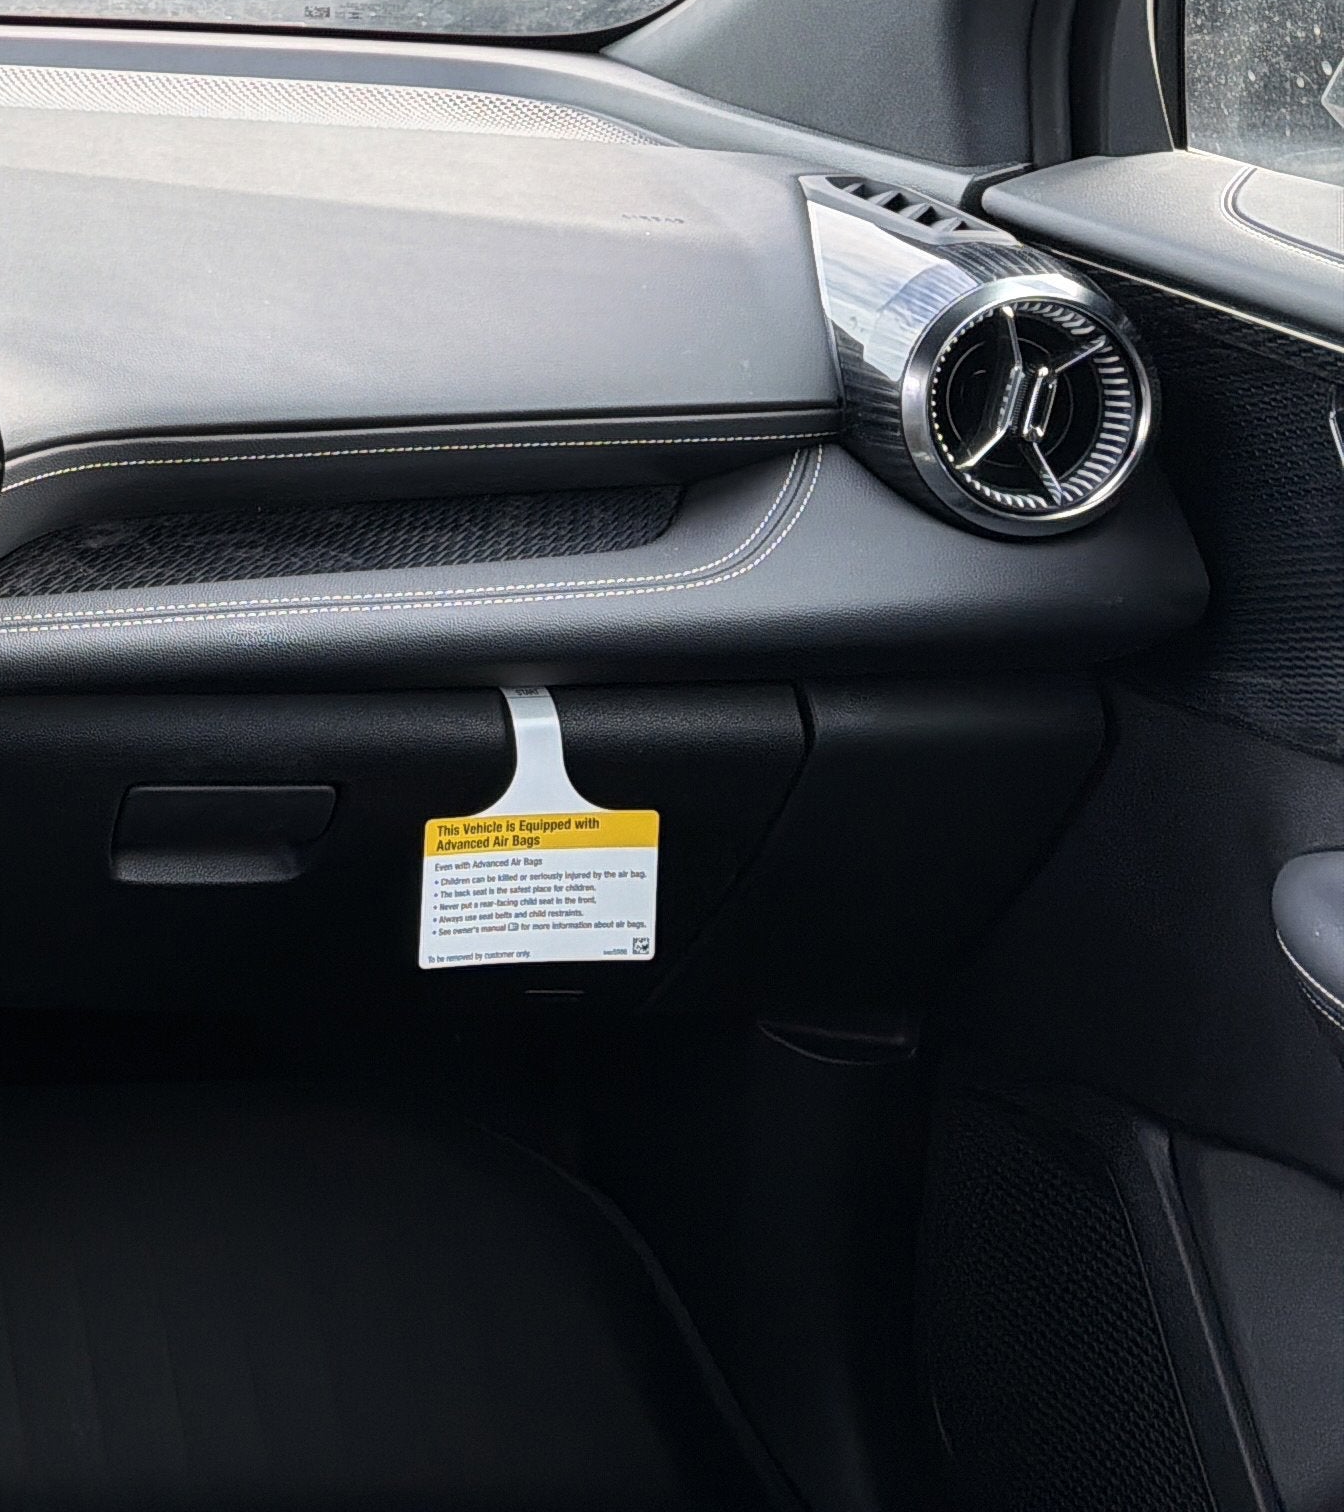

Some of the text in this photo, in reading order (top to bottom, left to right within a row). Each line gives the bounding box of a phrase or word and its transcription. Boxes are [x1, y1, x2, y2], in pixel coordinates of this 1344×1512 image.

[437, 817, 600, 837] This Vehicle is Equipped with
[436, 834, 541, 852] Advanced Air Bags
[434, 857, 543, 872] Even with Advanced Air Bags
[440, 877, 471, 887] Children
[472, 876, 485, 884] can
[486, 874, 496, 883] be
[497, 873, 518, 882] killed
[529, 872, 563, 881] seriously
[564, 870, 592, 881] injured
[592, 870, 602, 880] by
[603, 870, 616, 879] the
[618, 870, 629, 878] air
[440, 890, 453, 898] The
[454, 889, 471, 897] back
[472, 888, 487, 896] seat
[496, 886, 508, 894] the
[509, 885, 531, 894] safest
[532, 885, 552, 894] place
[553, 884, 564, 892] for
[439, 903, 459, 911] Never
[460, 901, 473, 911] put
[520, 897, 537, 906] child
[539, 896, 555, 905] seat
[555, 896, 563, 904] in
[564, 896, 576, 904] the
[439, 915, 464, 924] Always
[478, 912, 494, 920] seat
[495, 911, 513, 920] belts
[514, 910, 527, 919] and
[529, 909, 547, 918] child
[438, 927, 452, 936] See
[480, 924, 507, 933] manual
[520, 922, 531, 930] for
[551, 920, 592, 929] information
[593, 920, 614, 929] about
[615, 920, 625, 928] air
